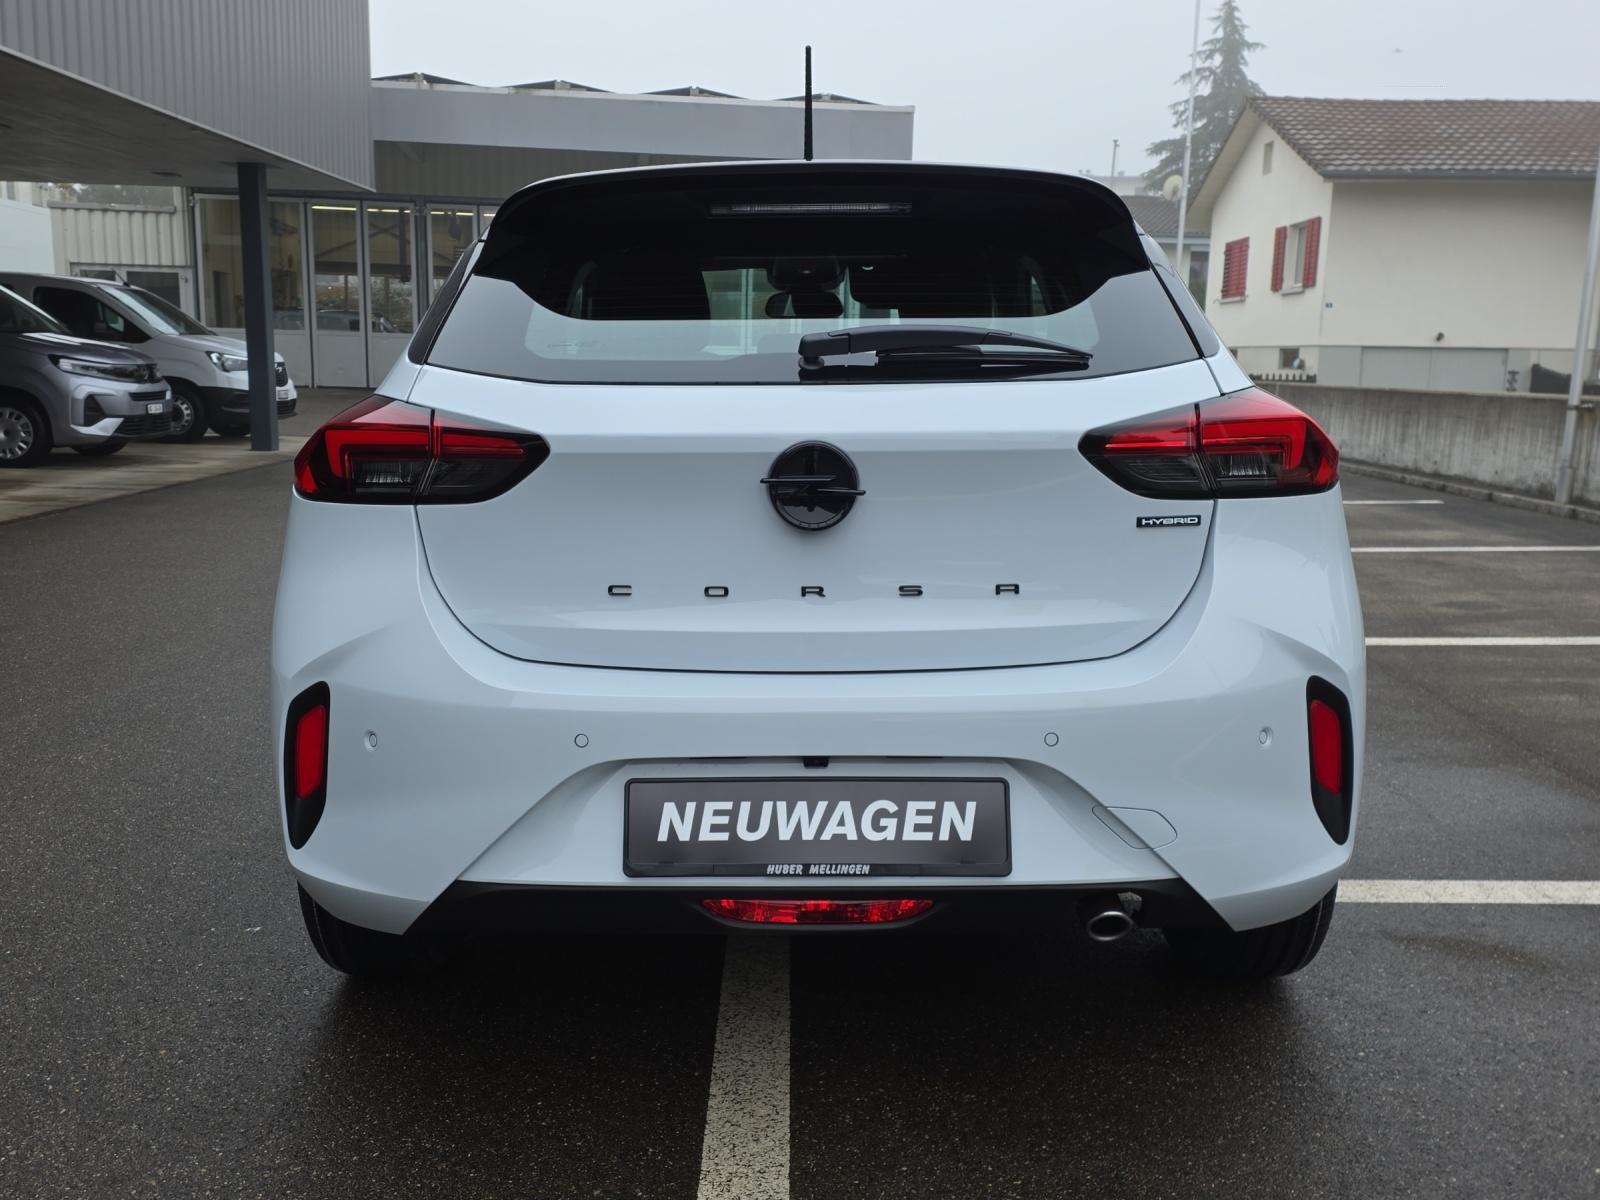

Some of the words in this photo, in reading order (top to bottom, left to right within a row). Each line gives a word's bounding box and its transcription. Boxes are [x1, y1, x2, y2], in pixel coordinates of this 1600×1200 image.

[1141, 516, 1199, 526] HYBRID
[607, 583, 1020, 597] CORSA
[657, 799, 977, 842] NEUWAGEN
[766, 864, 803, 875] HUBER
[809, 864, 870, 875] MELLINGEN
